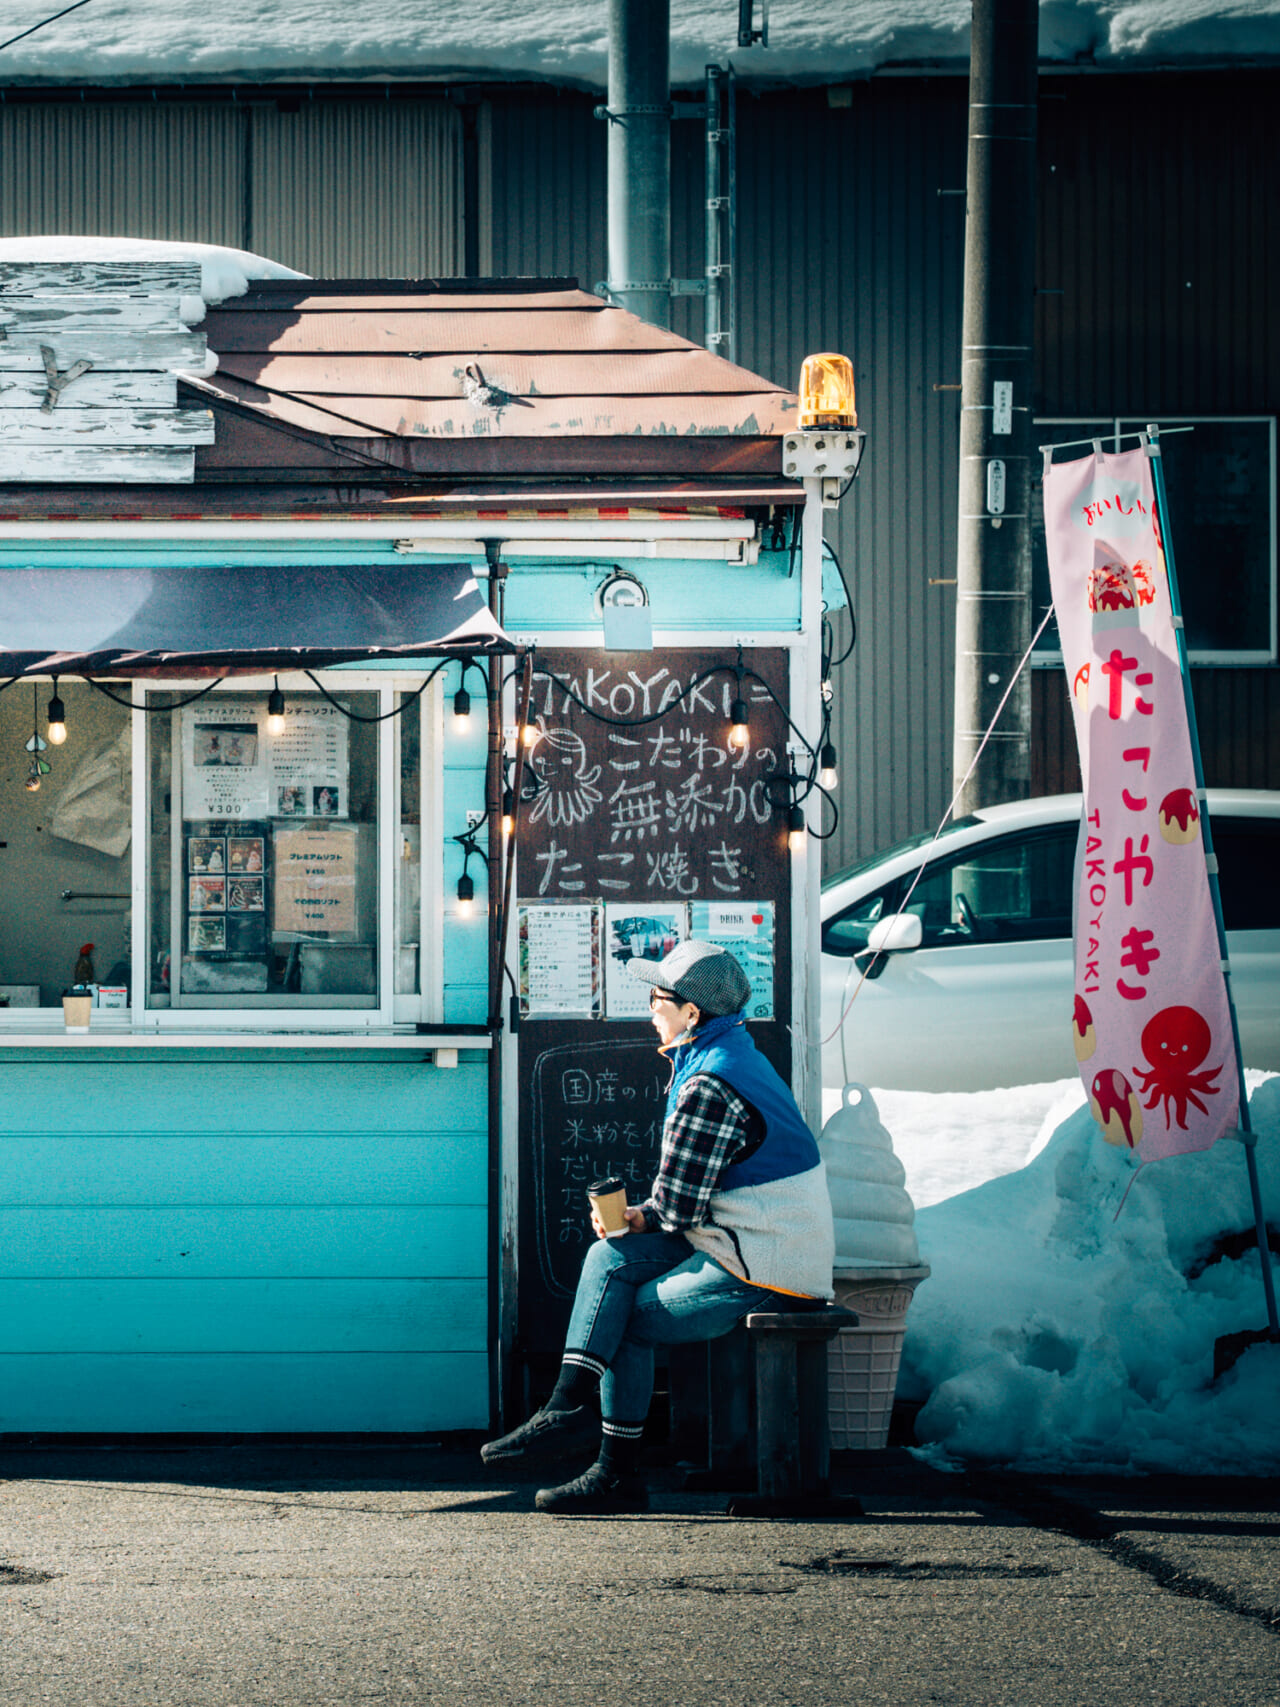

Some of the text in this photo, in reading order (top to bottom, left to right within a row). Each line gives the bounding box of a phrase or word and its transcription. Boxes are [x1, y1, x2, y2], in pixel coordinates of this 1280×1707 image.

[286, 707, 337, 715] ンデーソフト
[532, 668, 731, 718] TAKOYAKI
[609, 726, 777, 770] こだわりの
[608, 773, 772, 843] 無添加
[1101, 649, 1161, 1000] たこやき
[536, 840, 742, 895] たこ焼き
[720, 914, 744, 924] DRINK
[1084, 808, 1107, 993] TAKOYAKI
[562, 1068, 670, 1104] 国産の小
